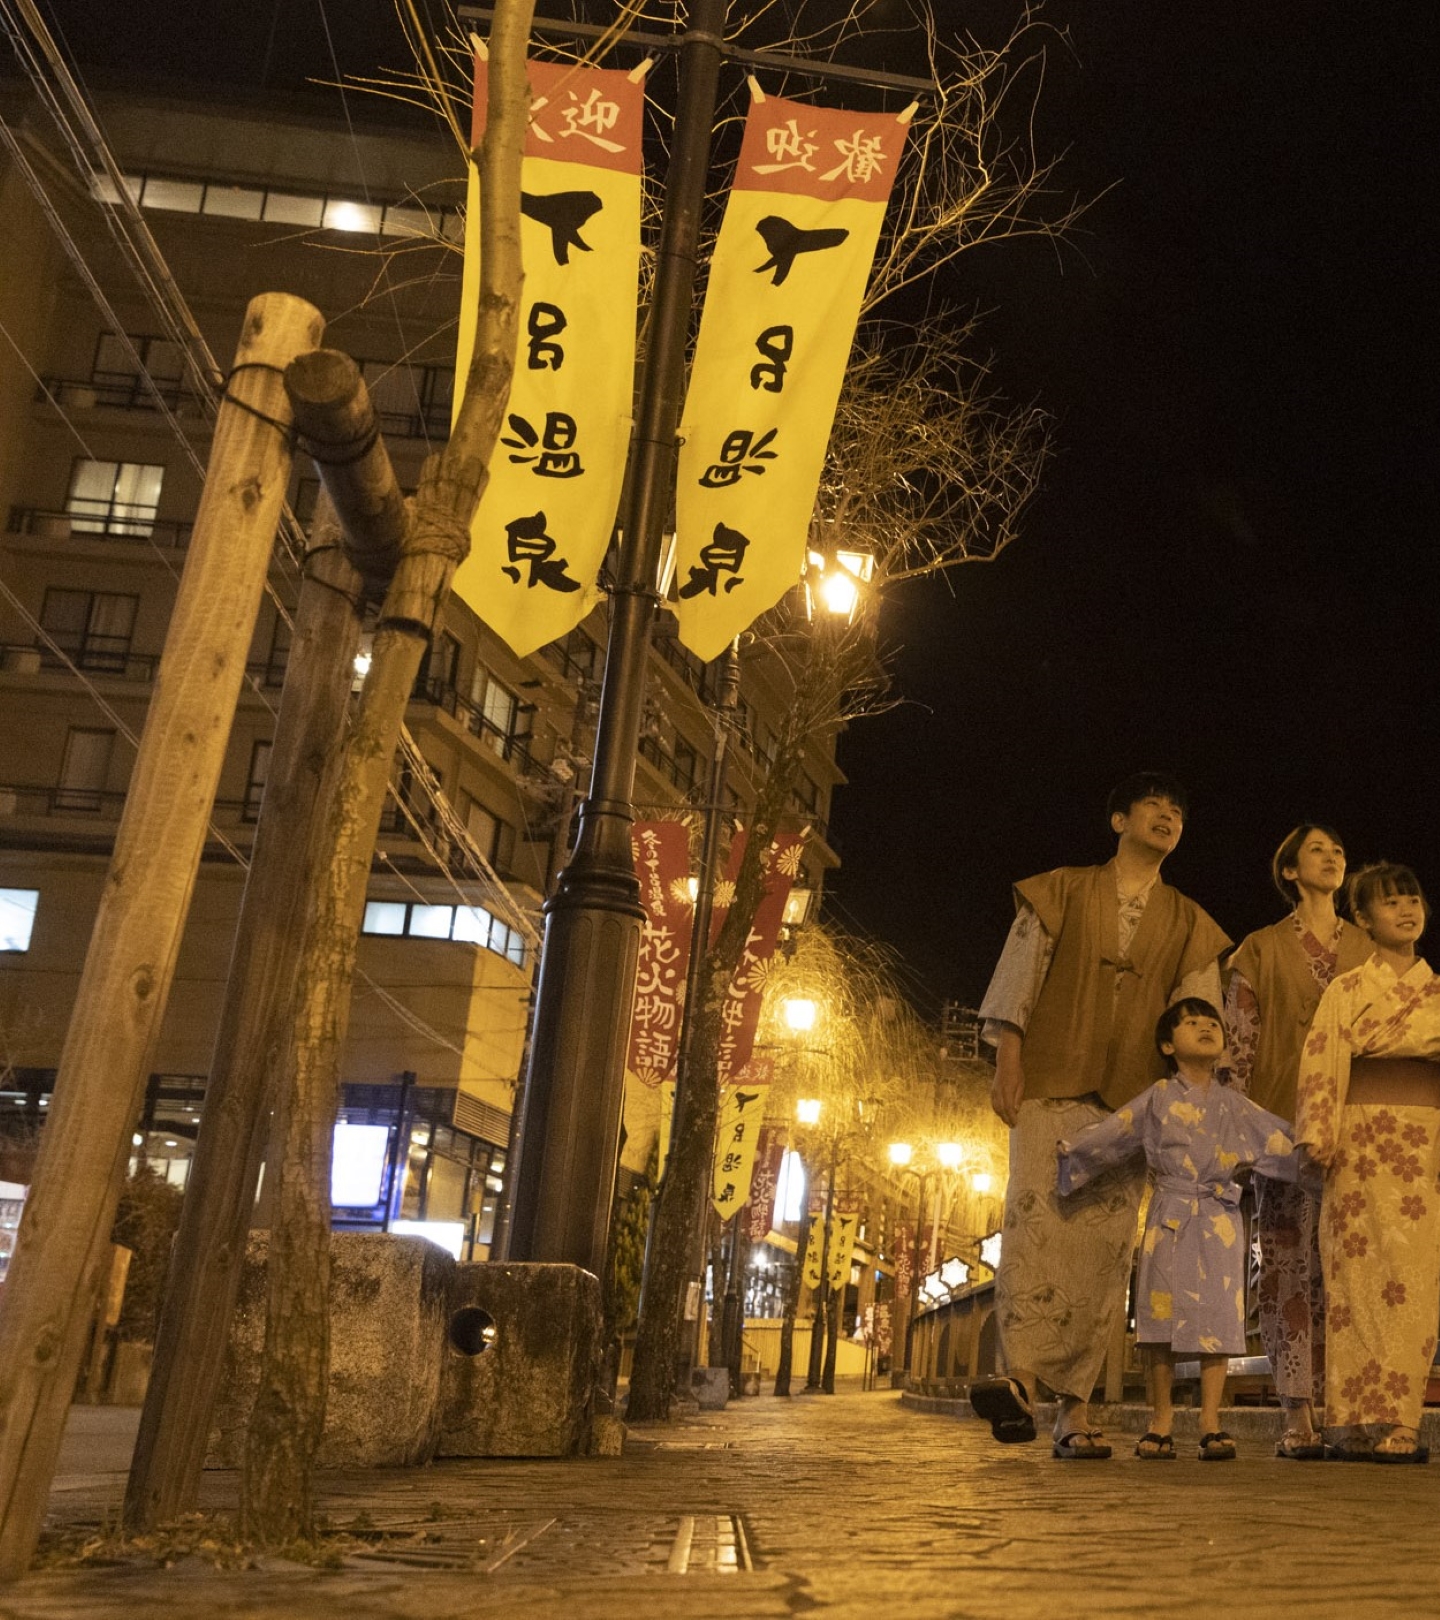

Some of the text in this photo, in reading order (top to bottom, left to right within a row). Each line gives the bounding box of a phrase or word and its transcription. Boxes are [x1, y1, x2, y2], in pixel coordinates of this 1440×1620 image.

[500, 189, 604, 594] 下呂温泉
[640, 829, 667, 917] 冬の下呂温泉
[632, 920, 681, 1069] 花火物語
